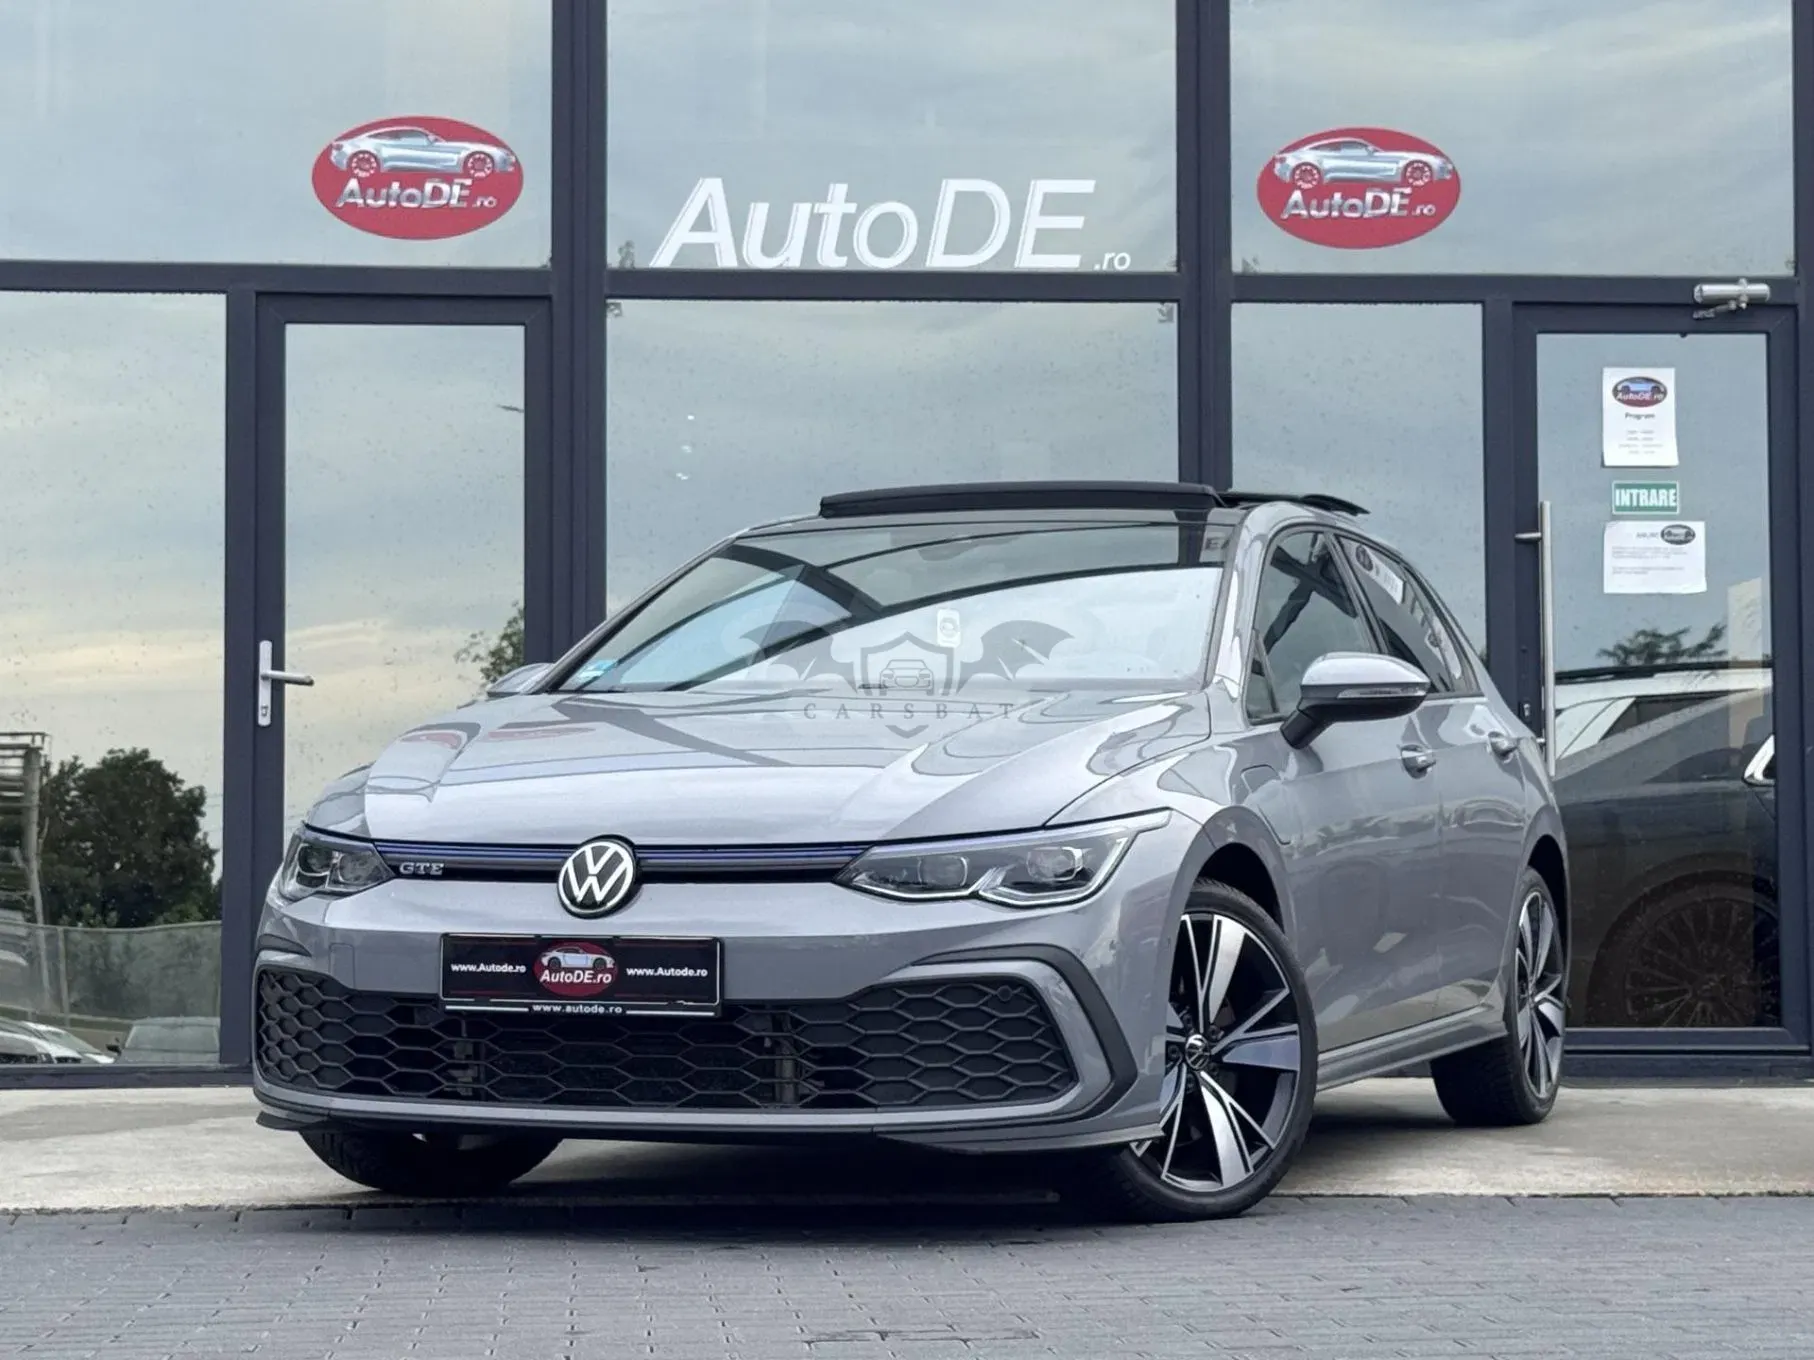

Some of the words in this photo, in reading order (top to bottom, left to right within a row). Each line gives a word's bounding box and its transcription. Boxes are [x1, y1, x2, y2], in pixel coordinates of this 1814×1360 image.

[1615, 488, 1677, 507] INTRARE
[399, 861, 445, 876] GTE
[450, 962, 527, 973] www.Autode.ro
[626, 966, 709, 978] www.Autode.ro
[539, 969, 613, 985] AutoDE.ro
[532, 1002, 623, 1014] www.autode.ro
